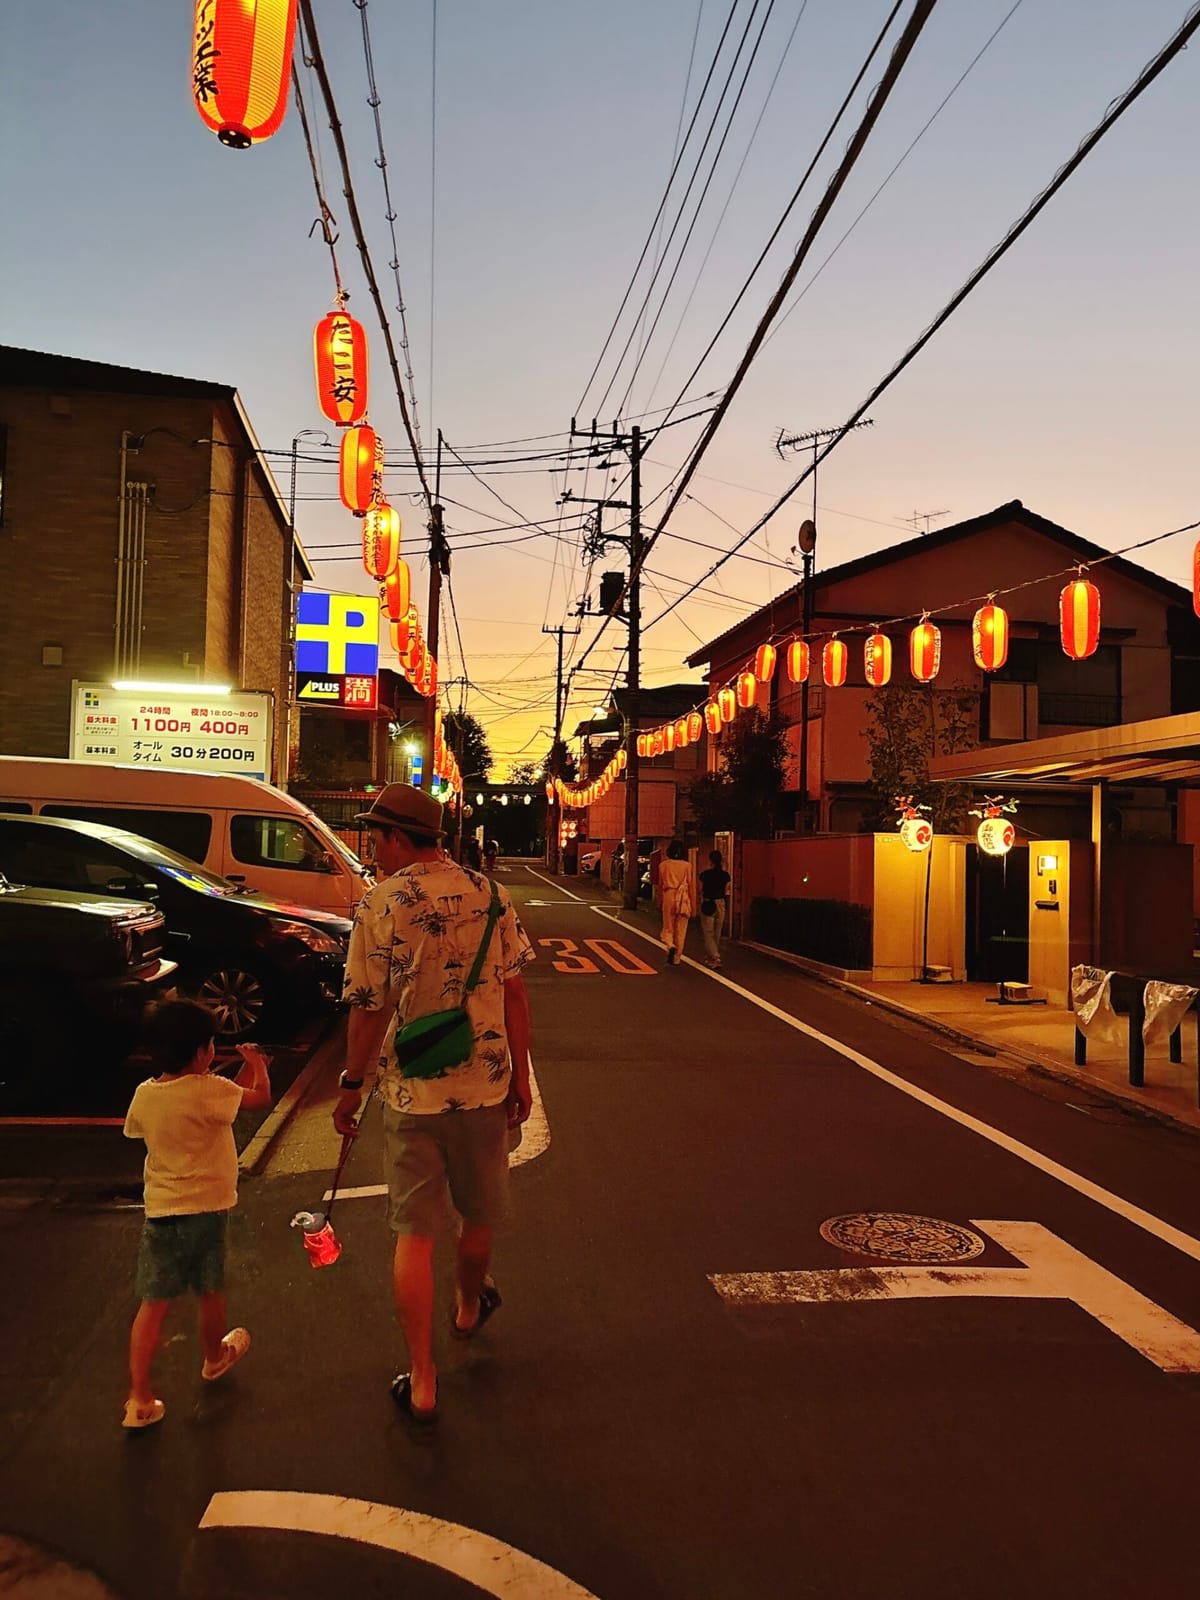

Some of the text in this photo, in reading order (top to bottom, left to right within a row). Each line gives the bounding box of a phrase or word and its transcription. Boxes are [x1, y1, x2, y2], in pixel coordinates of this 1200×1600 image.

[311, 682, 340, 692] PLUS
[344, 677, 373, 704] 満
[139, 706, 171, 715] 24時間
[190, 708, 208, 717] 夜間
[86, 715, 117, 724] 最大料金
[131, 717, 191, 733] 1100円
[199, 720, 249, 736] 400円
[133, 740, 163, 750] オール
[85, 746, 116, 755] 基本料金
[132, 752, 162, 762] タイム
[537, 938, 658, 975] 30
